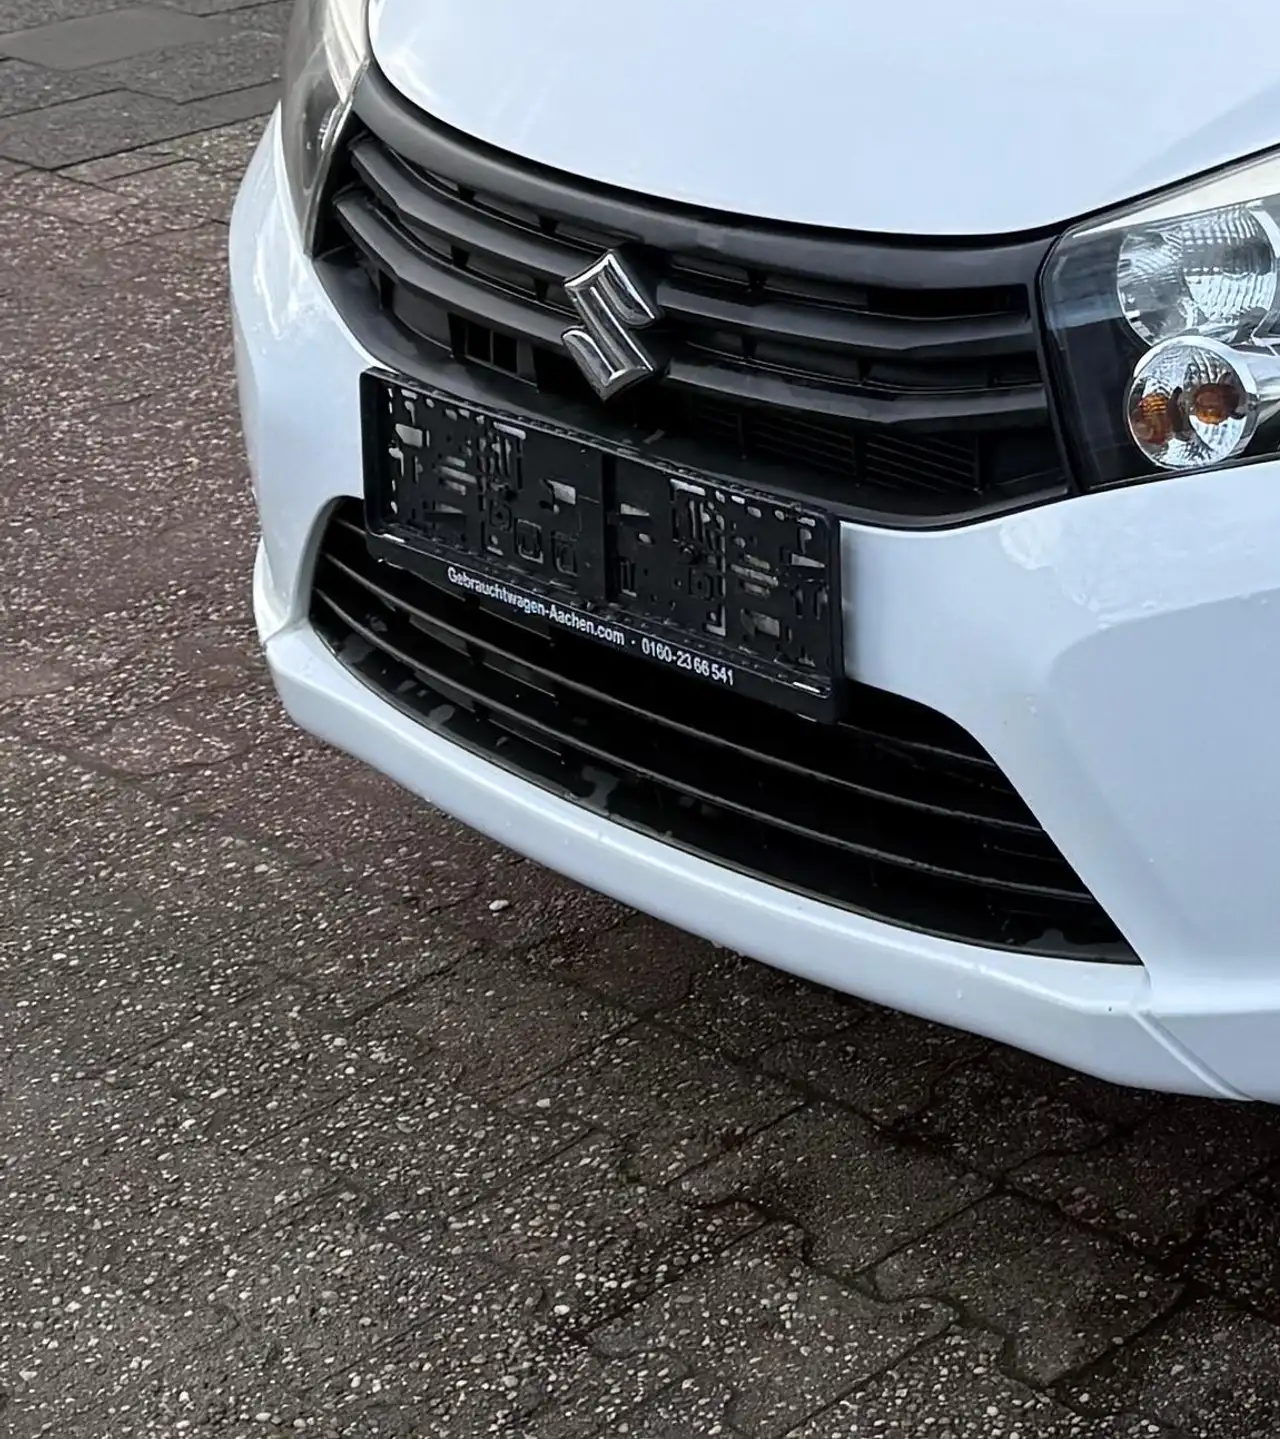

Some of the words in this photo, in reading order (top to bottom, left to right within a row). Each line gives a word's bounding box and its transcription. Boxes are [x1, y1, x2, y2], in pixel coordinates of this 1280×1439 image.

[447, 566, 626, 647] Gebrauchtwagen-Aachen.com
[640, 636, 693, 671] 0160-23
[693, 656, 710, 677] 66
[711, 662, 734, 687] 541
